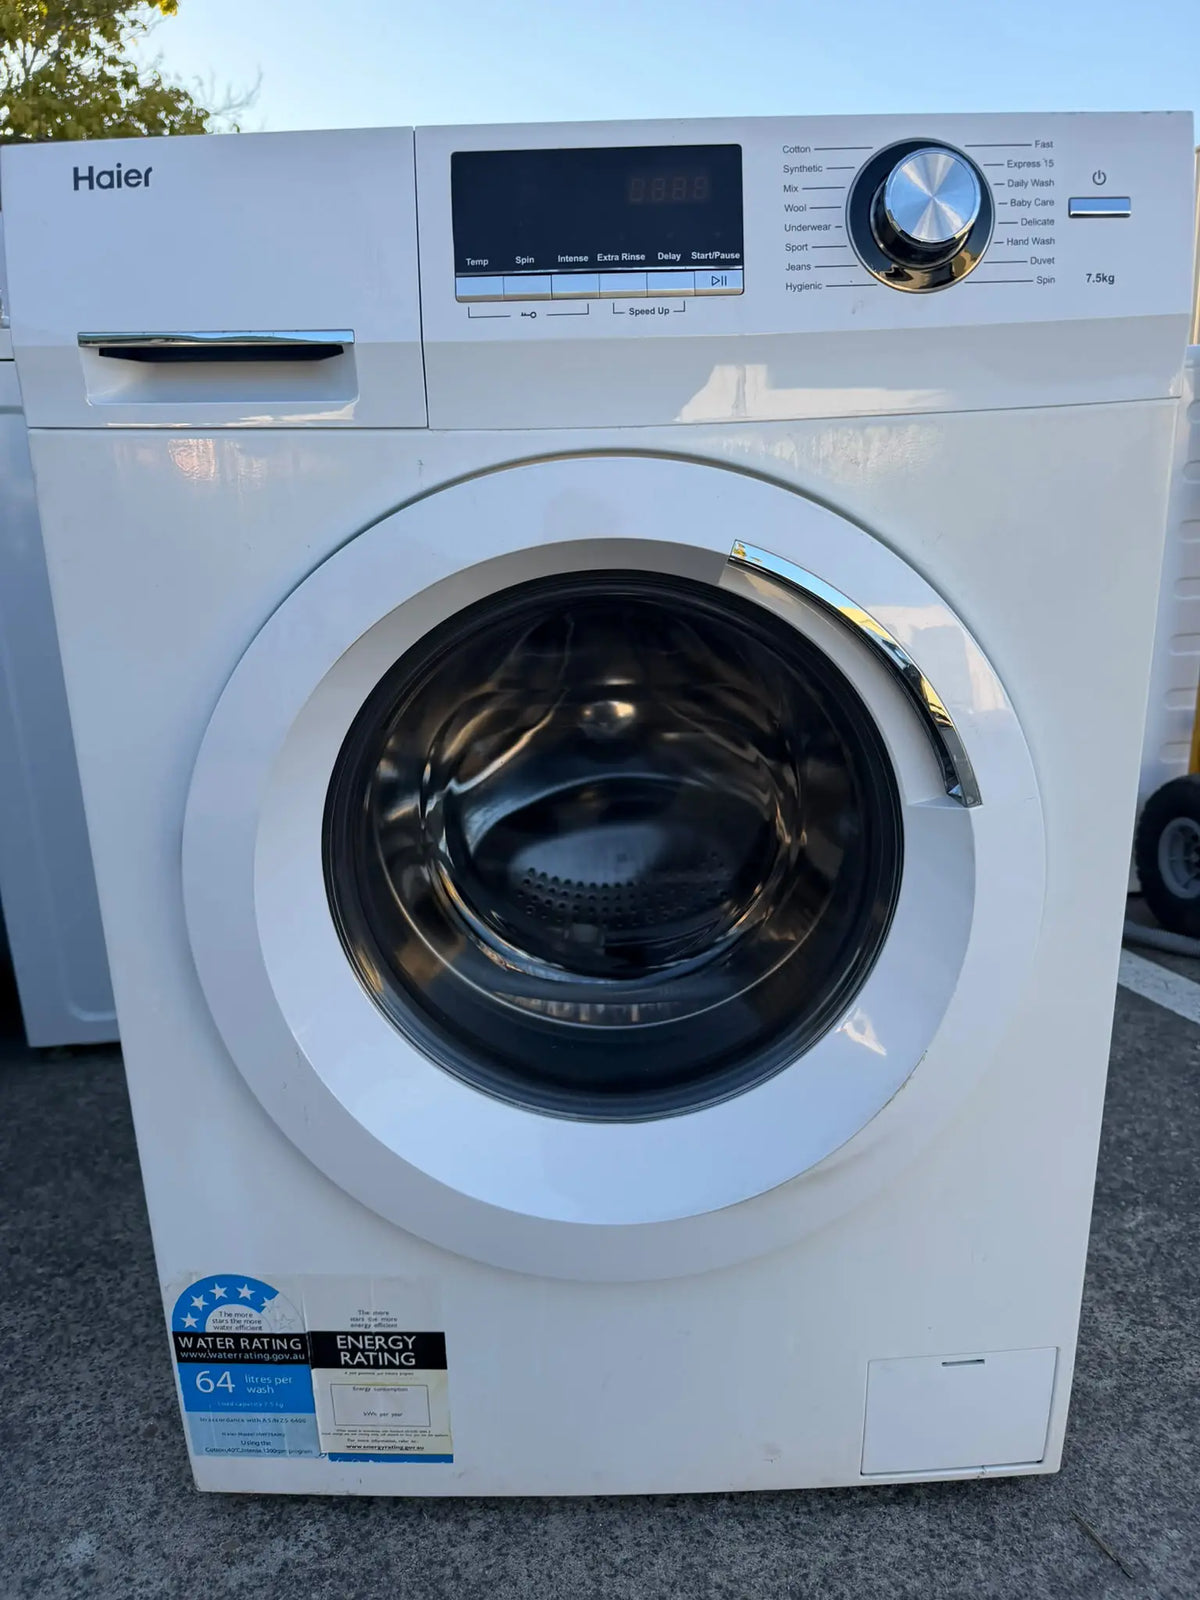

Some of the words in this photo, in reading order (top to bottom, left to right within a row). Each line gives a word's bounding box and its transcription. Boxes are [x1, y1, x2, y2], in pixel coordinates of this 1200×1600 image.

[1035, 140, 1053, 149] Fast
[782, 145, 811, 154] Cotton
[1006, 160, 1041, 169] Express
[783, 164, 823, 175] Synthetic
[73, 162, 153, 191] Haier
[783, 184, 799, 193] Mix
[1007, 179, 1028, 189] Daily
[1031, 179, 1055, 187] Wash
[1010, 199, 1032, 208] Baby
[1034, 198, 1055, 207] Care
[784, 204, 807, 213] Wool
[1021, 217, 1055, 226] Delicate
[784, 223, 831, 232] Underwear
[1006, 237, 1029, 246] Hand
[1031, 237, 1056, 246] Wash
[785, 243, 808, 253] Sport
[515, 256, 535, 265] Spin
[557, 255, 589, 263] Intense
[597, 254, 620, 262] Extra
[621, 253, 646, 261] Rinse
[657, 252, 681, 261] Delay
[691, 252, 741, 260] Start/Pause
[1030, 256, 1055, 265] Duvet
[466, 258, 489, 266] Temp
[786, 263, 812, 272] Jeans
[1036, 276, 1056, 285] Spin
[1086, 273, 1115, 285] 7.5kg
[785, 282, 823, 293] Hygienic
[629, 307, 655, 317] Speed
[658, 306, 670, 315] Up
[179, 1337, 235, 1349] WATER
[240, 1338, 302, 1350] RATING
[336, 1335, 416, 1350] ENERGY
[180, 1350, 305, 1361] www.waterrating.gov.au
[340, 1351, 416, 1366] RATING
[195, 1370, 236, 1393] 64
[244, 1374, 272, 1384] litres
[274, 1377, 292, 1385] per
[246, 1385, 274, 1394] wash
